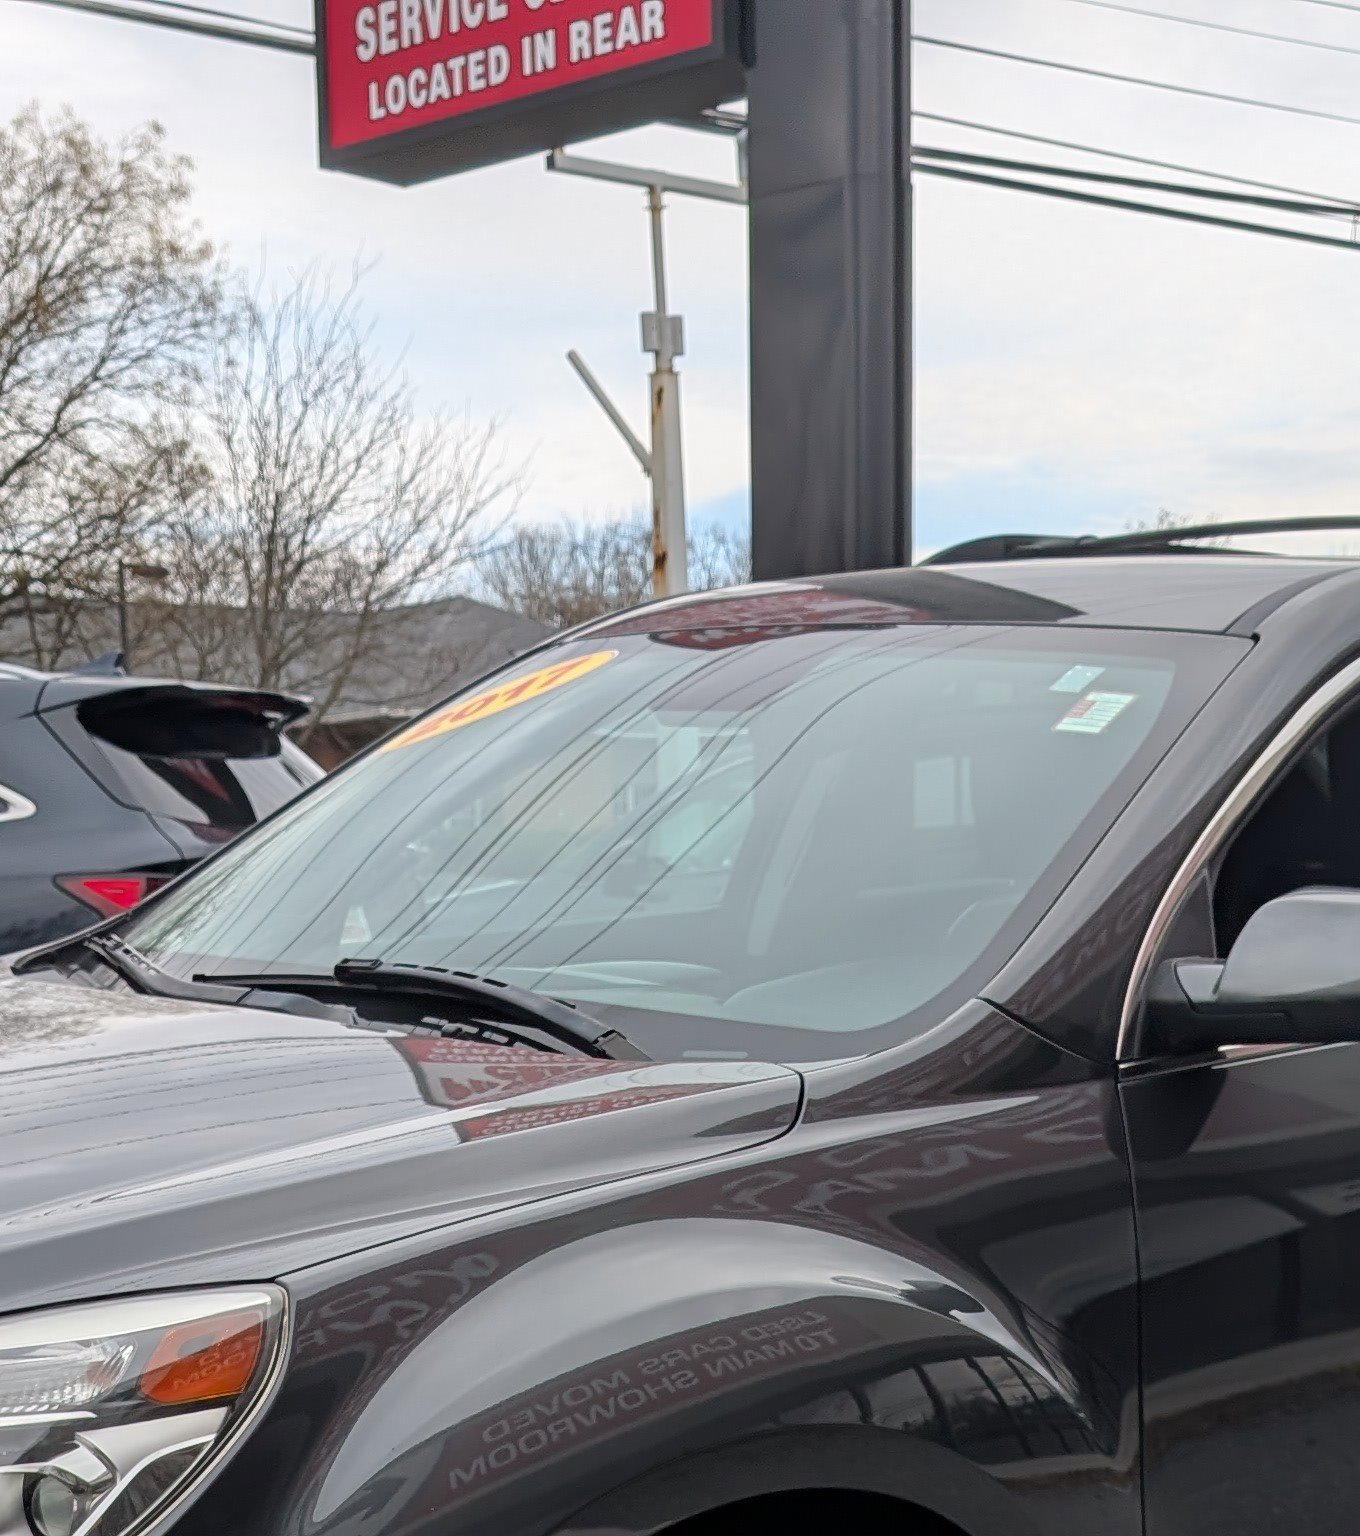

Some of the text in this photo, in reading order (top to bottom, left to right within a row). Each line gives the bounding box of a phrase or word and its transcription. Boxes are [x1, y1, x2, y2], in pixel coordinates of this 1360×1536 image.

[367, 1, 666, 121] LOCATED IN REAR
